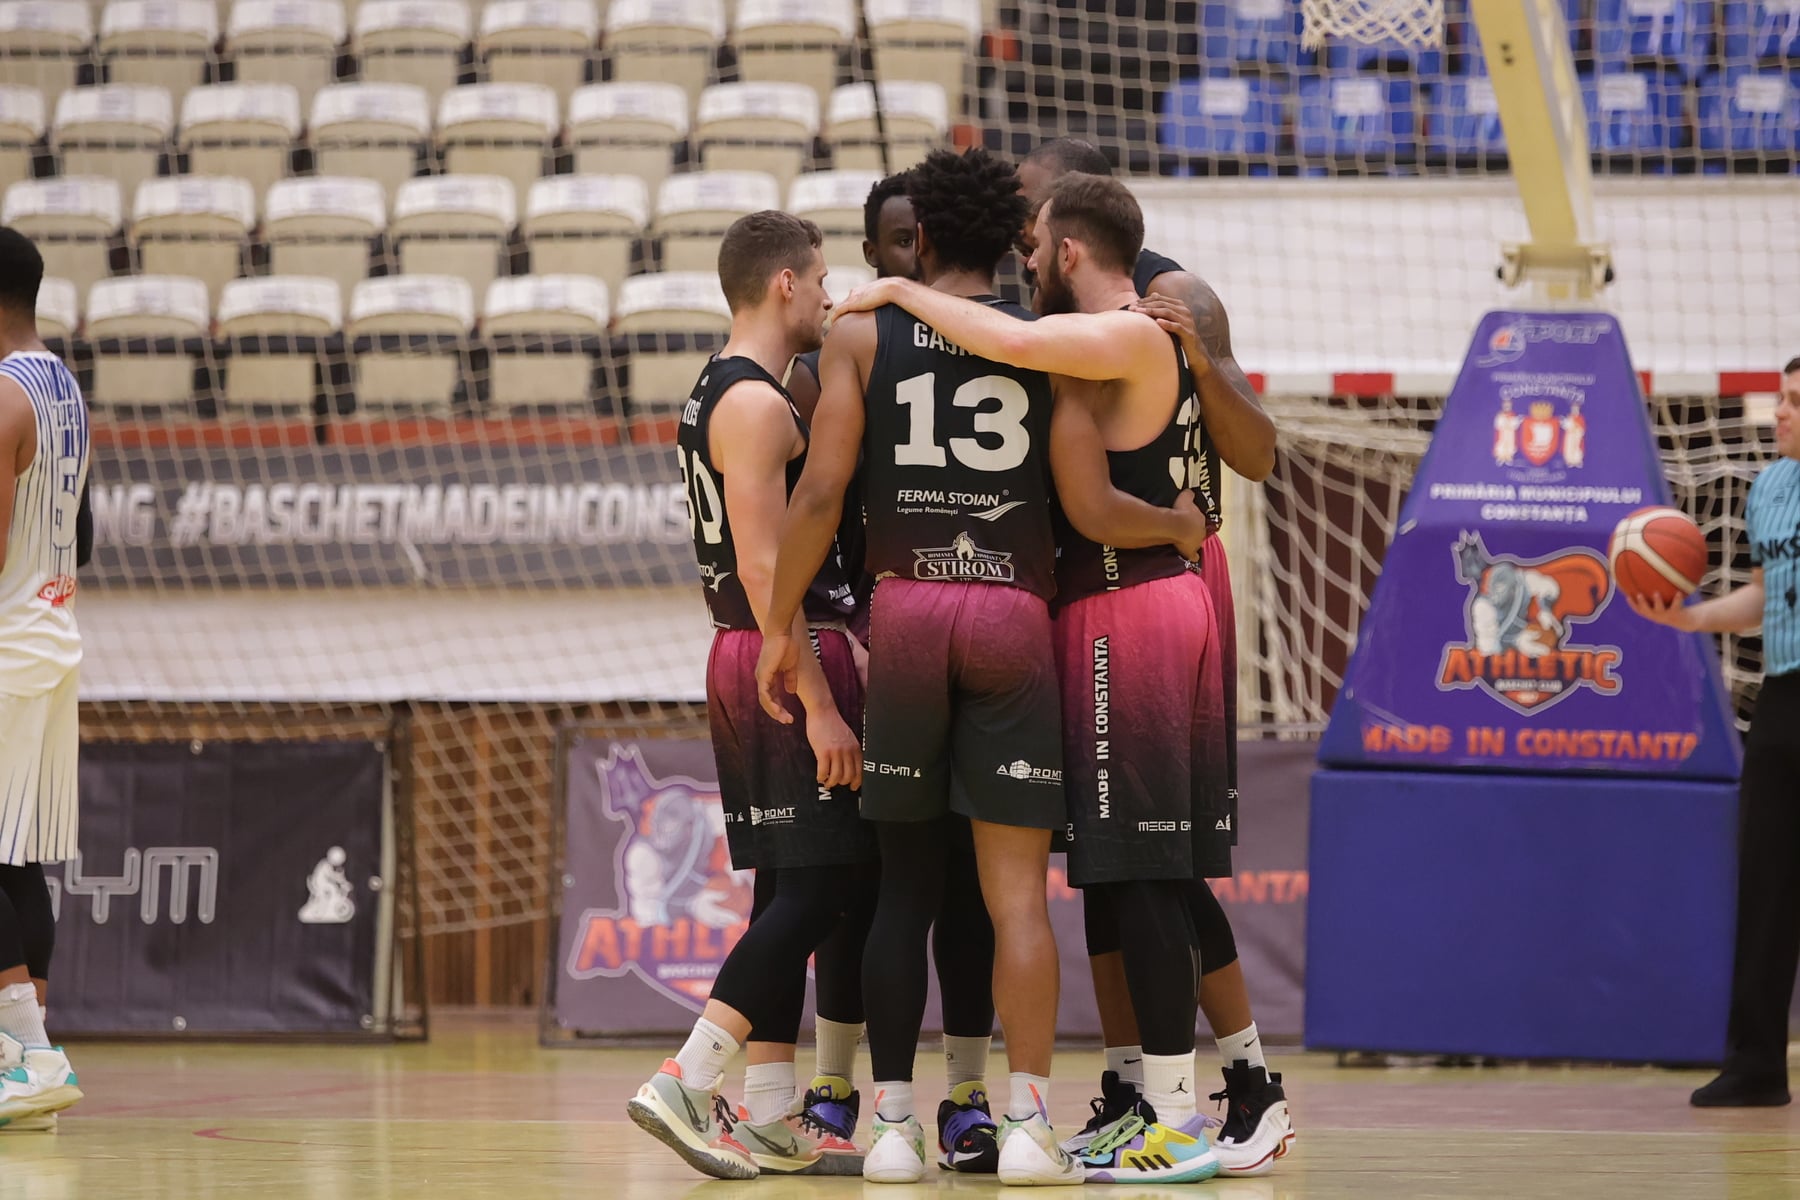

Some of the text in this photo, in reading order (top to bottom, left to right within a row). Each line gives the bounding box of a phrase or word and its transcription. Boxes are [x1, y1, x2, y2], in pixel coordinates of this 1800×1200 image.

[895, 372, 1030, 471] 13
[897, 490, 999, 506] FERMA STOIAN
[927, 561, 1003, 577] STIROM
[1442, 648, 1618, 689] ATHLETIC
[1094, 636, 1110, 819] MADE IN CONSTANTA
[1466, 726, 1505, 756] IN
[880, 763, 910, 777] GYM
[1138, 821, 1176, 832] MEGA
